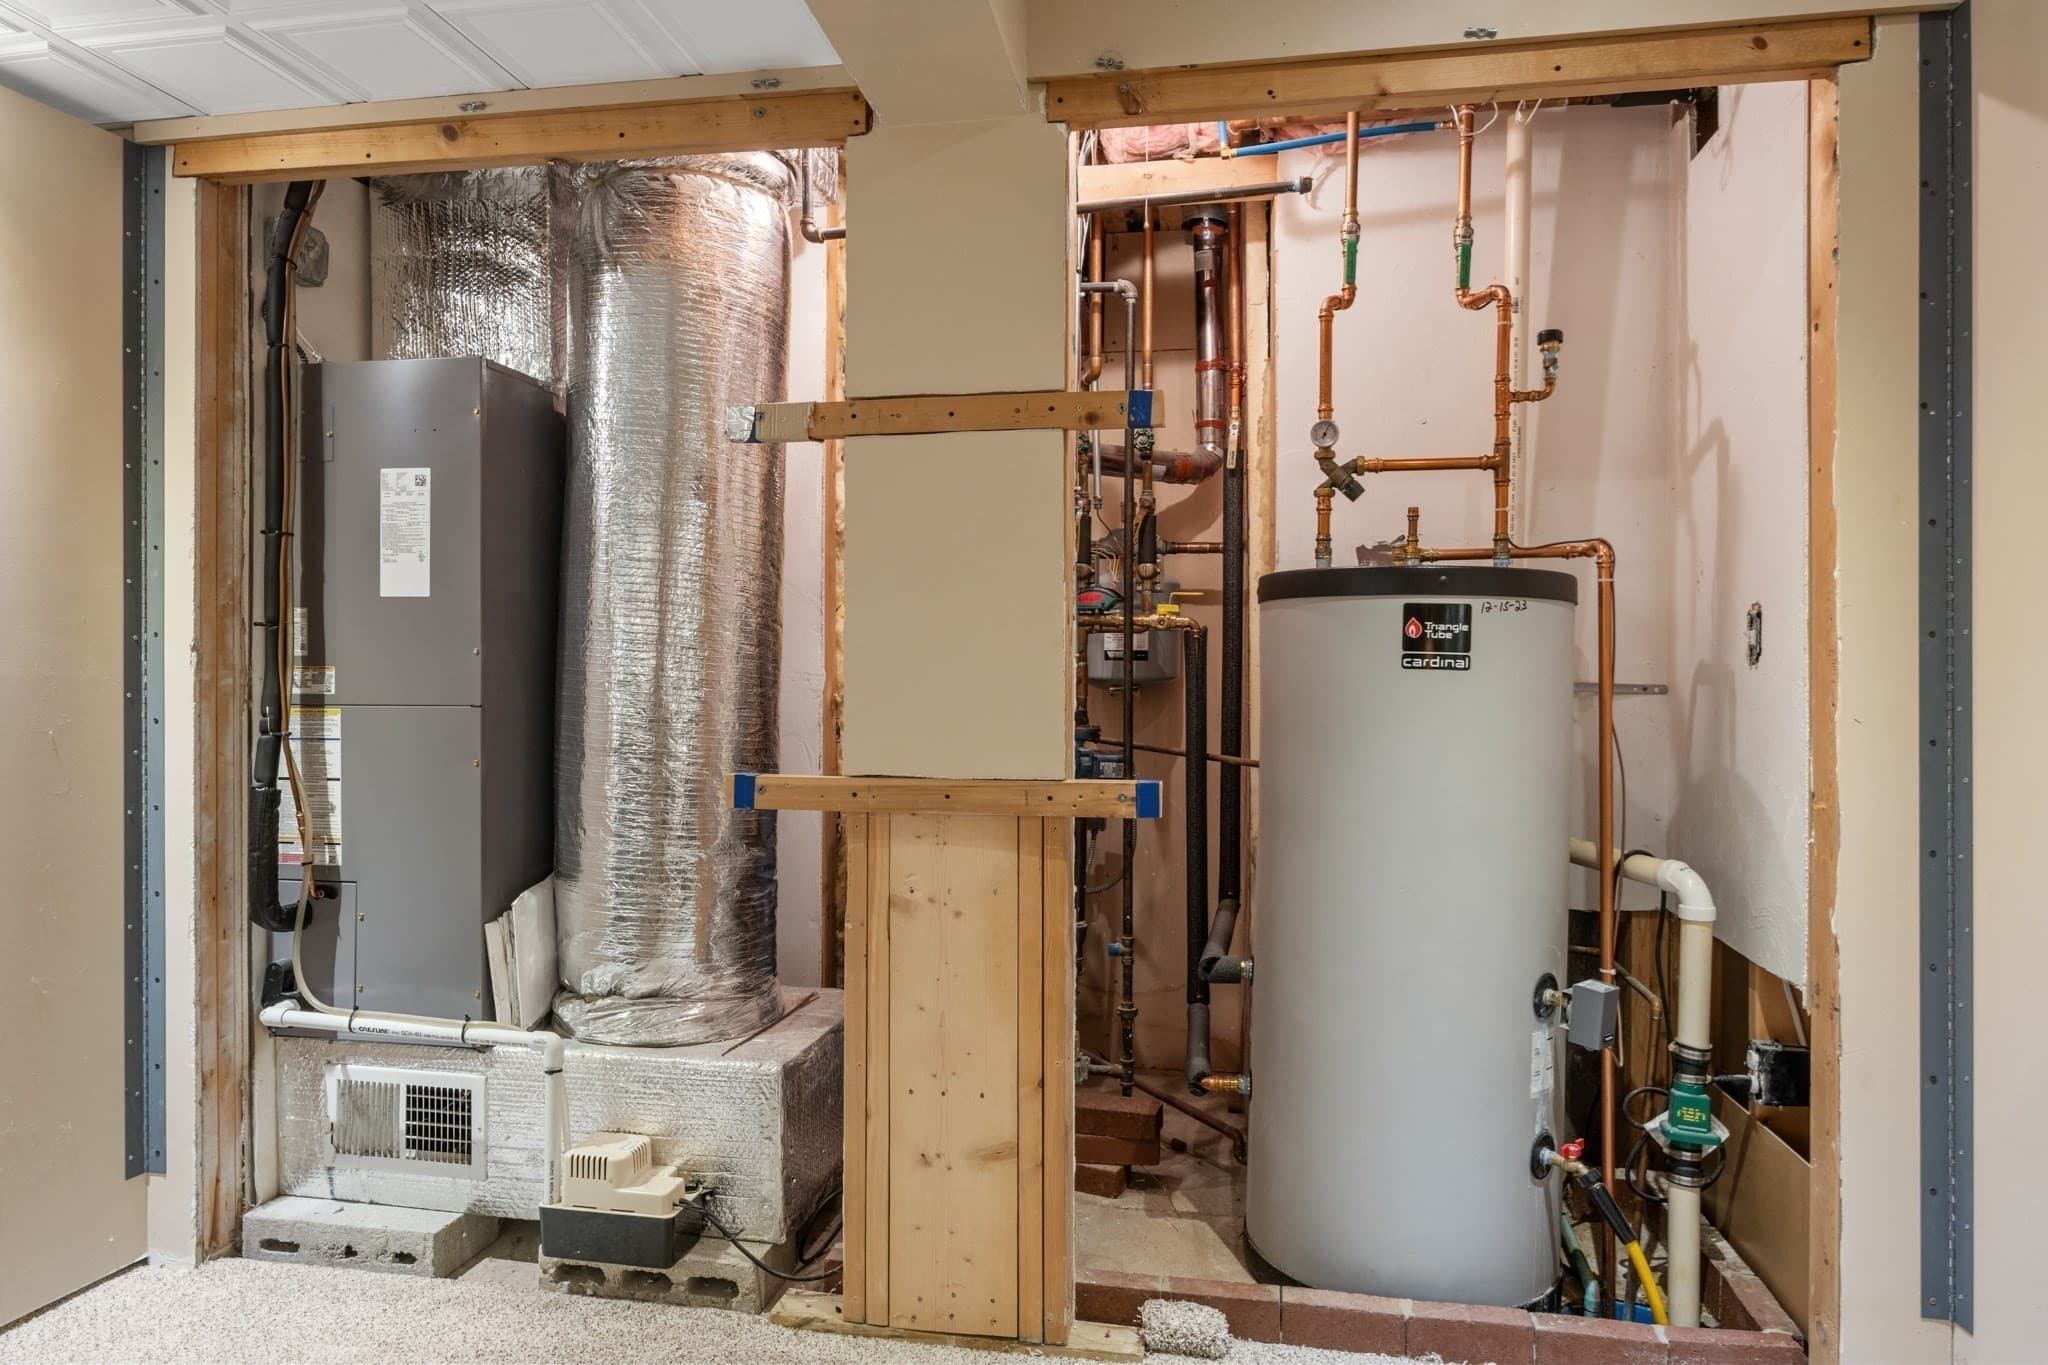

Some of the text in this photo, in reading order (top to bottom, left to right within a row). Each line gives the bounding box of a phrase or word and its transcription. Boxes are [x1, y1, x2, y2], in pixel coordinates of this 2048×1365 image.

[1481, 600, 1527, 613] 12-15-23
[1424, 621, 1469, 633] Triangle
[1424, 630, 1453, 639] Tube
[1403, 656, 1469, 668] cardinal
